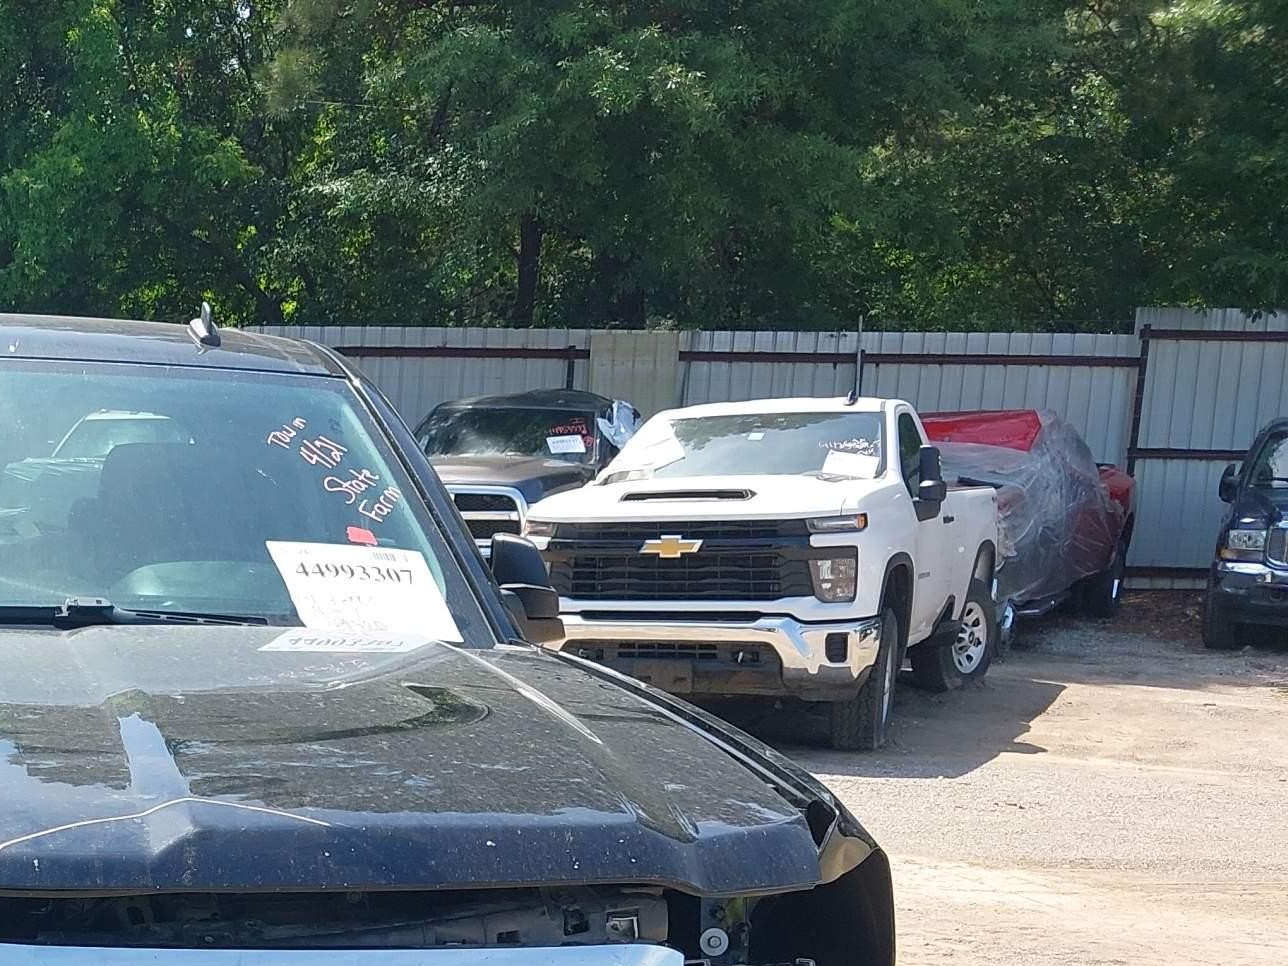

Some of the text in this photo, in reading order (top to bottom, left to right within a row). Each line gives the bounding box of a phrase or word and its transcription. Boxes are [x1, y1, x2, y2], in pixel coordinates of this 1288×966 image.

[299, 435, 348, 469] 4/21
[323, 469, 380, 505] State
[358, 486, 402, 522] Farm
[295, 561, 413, 585] 44993307
